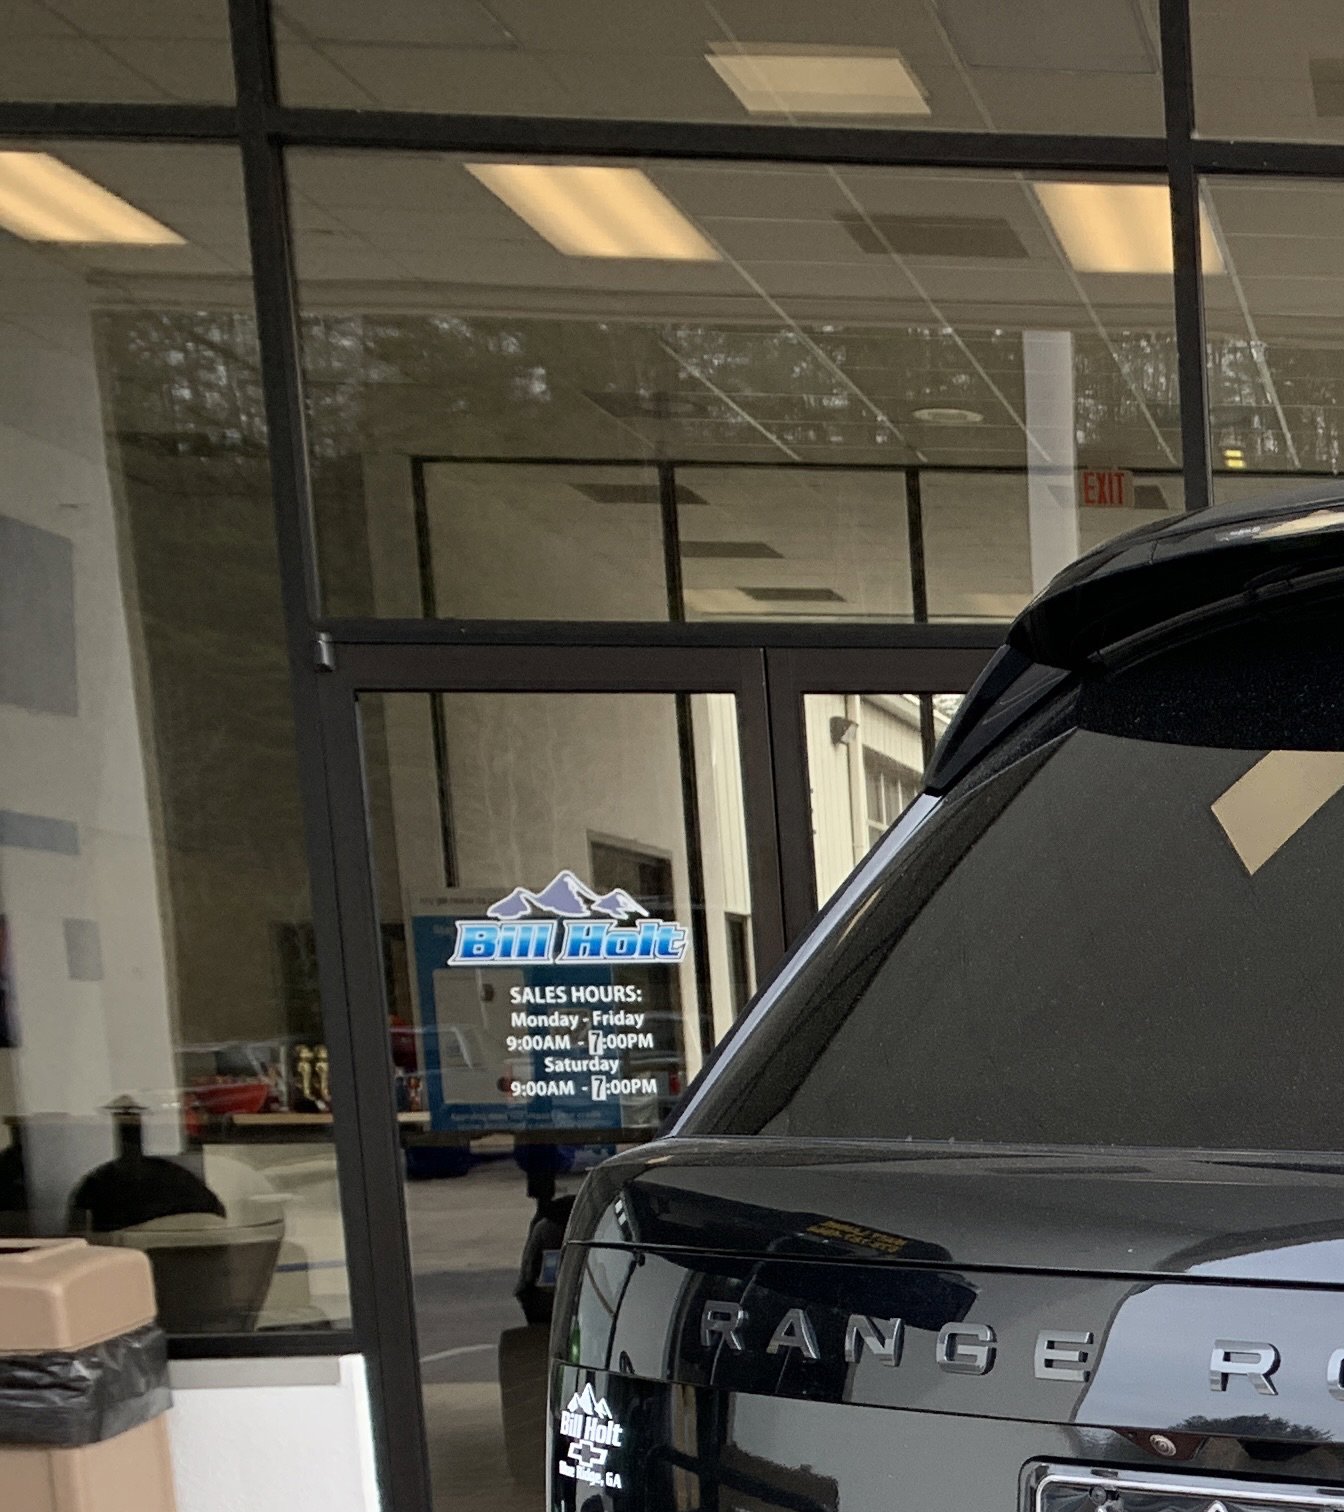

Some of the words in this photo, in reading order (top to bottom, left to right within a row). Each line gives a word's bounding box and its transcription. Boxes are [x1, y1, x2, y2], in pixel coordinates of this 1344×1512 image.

[1083, 472, 1124, 505] EXIT
[447, 919, 557, 965] Bill
[555, 919, 689, 965] Holt
[510, 986, 567, 1004] SALES
[571, 985, 643, 1002] HOURS:
[511, 1011, 579, 1030] Monday
[592, 1010, 645, 1028] Friday
[506, 1035, 571, 1051] 9:00AM
[588, 1030, 654, 1055] 7:00PM
[544, 1056, 619, 1074] Saturday
[510, 1080, 575, 1096] 9:00AM
[591, 1075, 658, 1101] 7:00PM
[700, 1299, 1095, 1383] RANGE
[560, 1410, 583, 1439] Bill
[583, 1415, 623, 1447] Holt
[605, 1471, 622, 1489] GA
